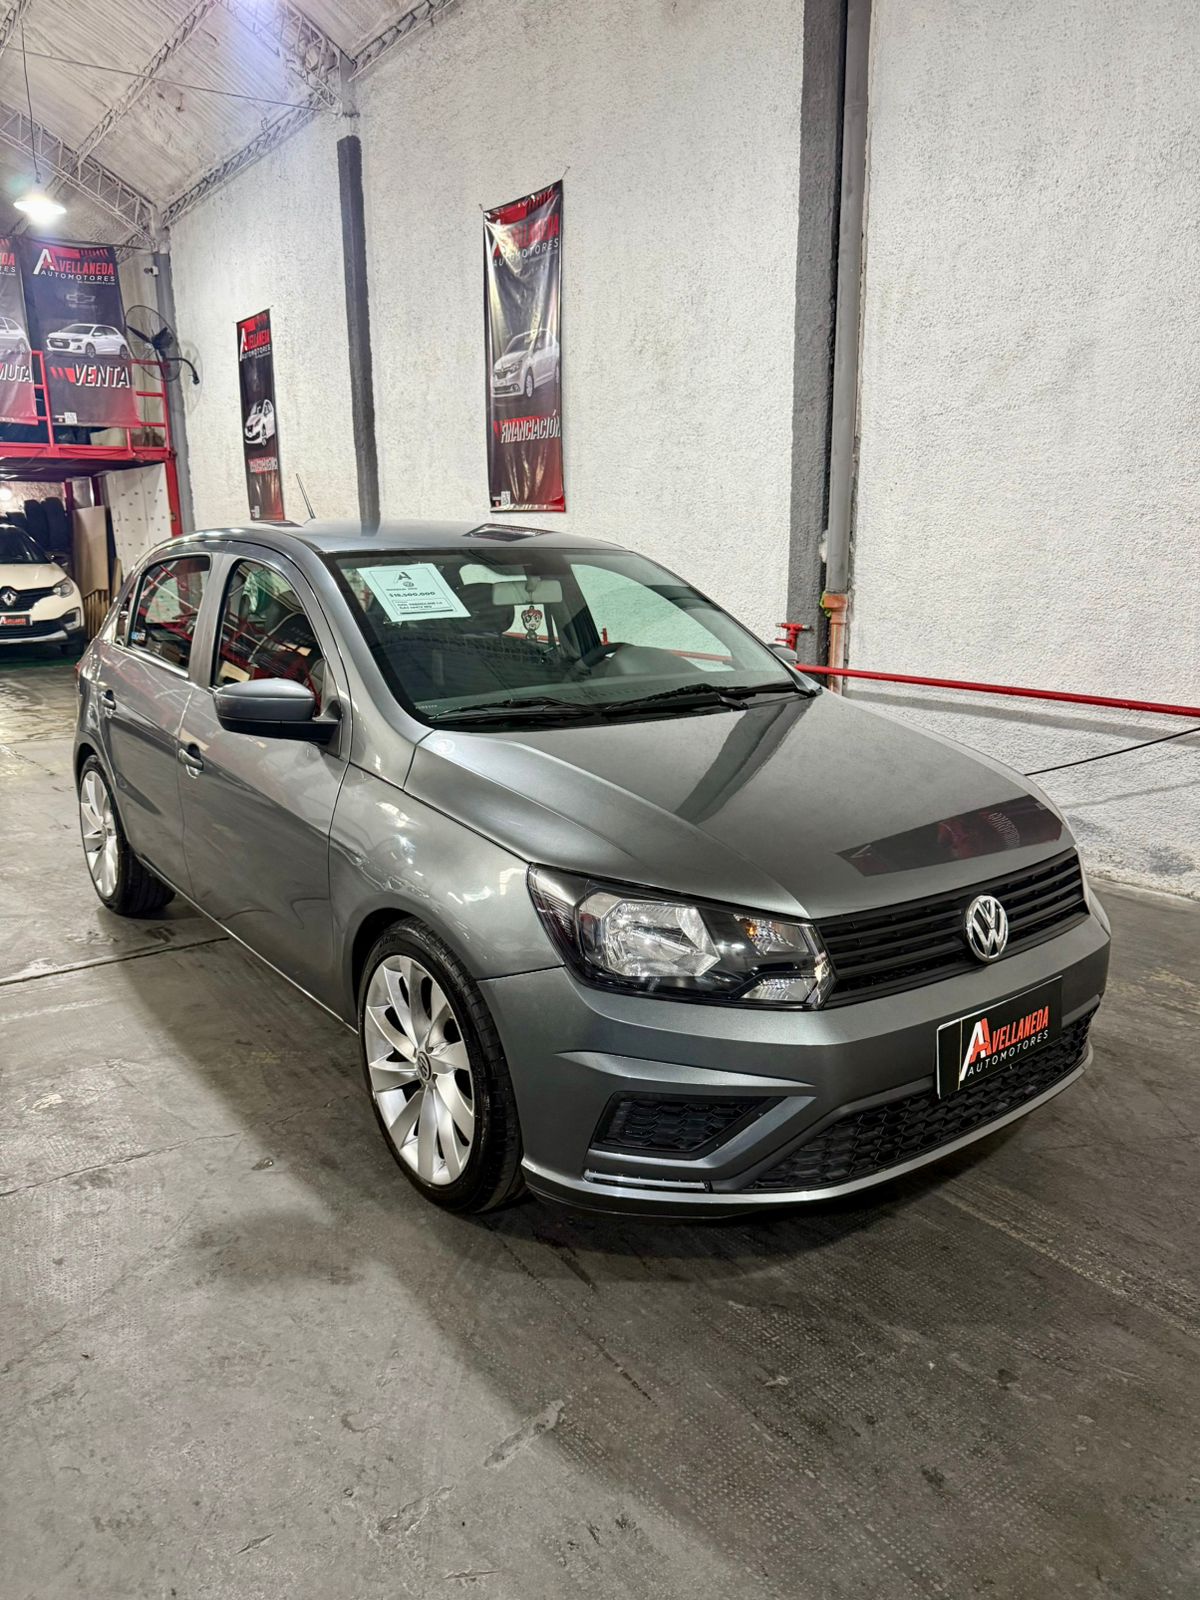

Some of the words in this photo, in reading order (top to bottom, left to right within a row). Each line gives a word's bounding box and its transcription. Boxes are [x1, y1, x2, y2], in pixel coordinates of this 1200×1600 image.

[33, 249, 115, 275] AVELLANEDA
[41, 270, 115, 282] AUTOMOTORES
[74, 364, 130, 389] VENTA
[958, 1006, 1049, 1082] AVELLANEDA
[967, 1029, 1049, 1077] AUTOMOTORES
